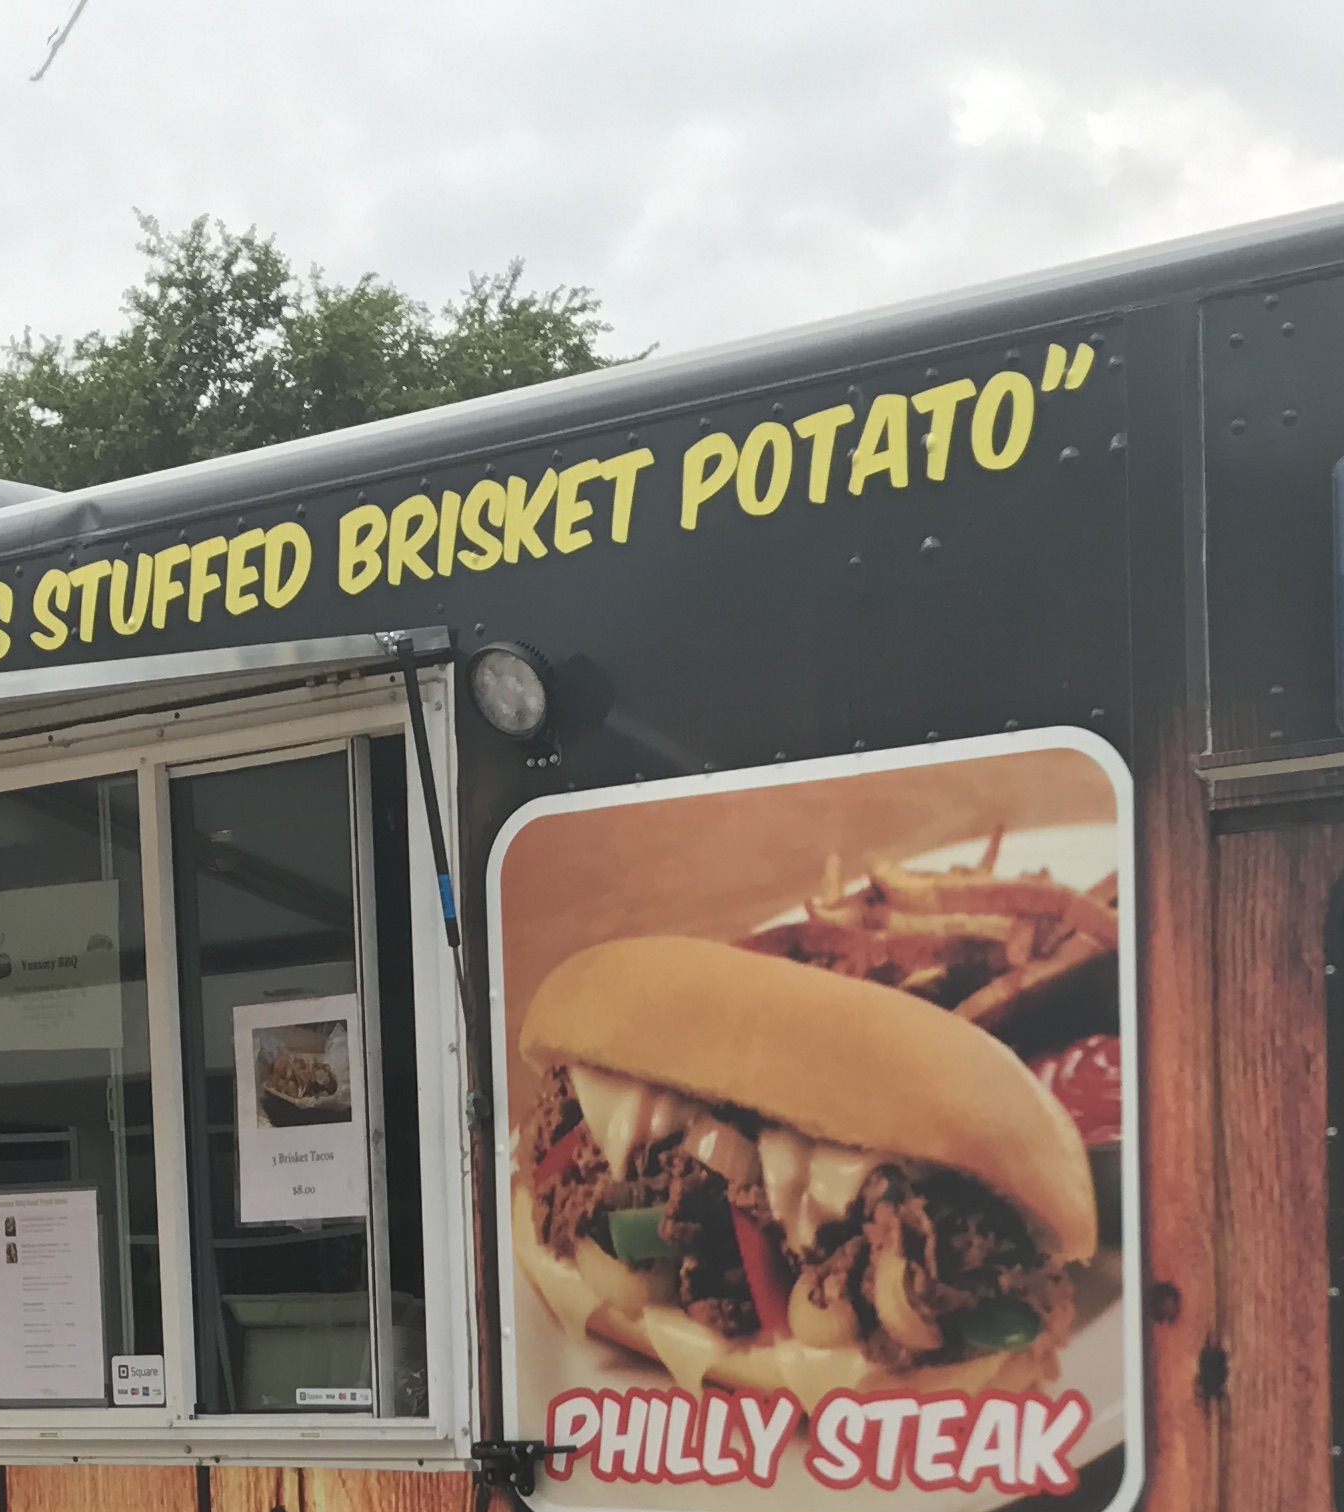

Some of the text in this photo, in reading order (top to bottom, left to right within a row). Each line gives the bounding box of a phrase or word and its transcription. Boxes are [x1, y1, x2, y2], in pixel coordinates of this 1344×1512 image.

[31, 521, 313, 651] STUFFED
[338, 448, 654, 595] BRISKET
[278, 1150, 309, 1164] Brisket
[309, 1150, 335, 1162] Tacos
[292, 1184, 316, 1196] $8.00
[131, 1366, 159, 1378] Square
[551, 1396, 1083, 1488] PHILLY STEAK
